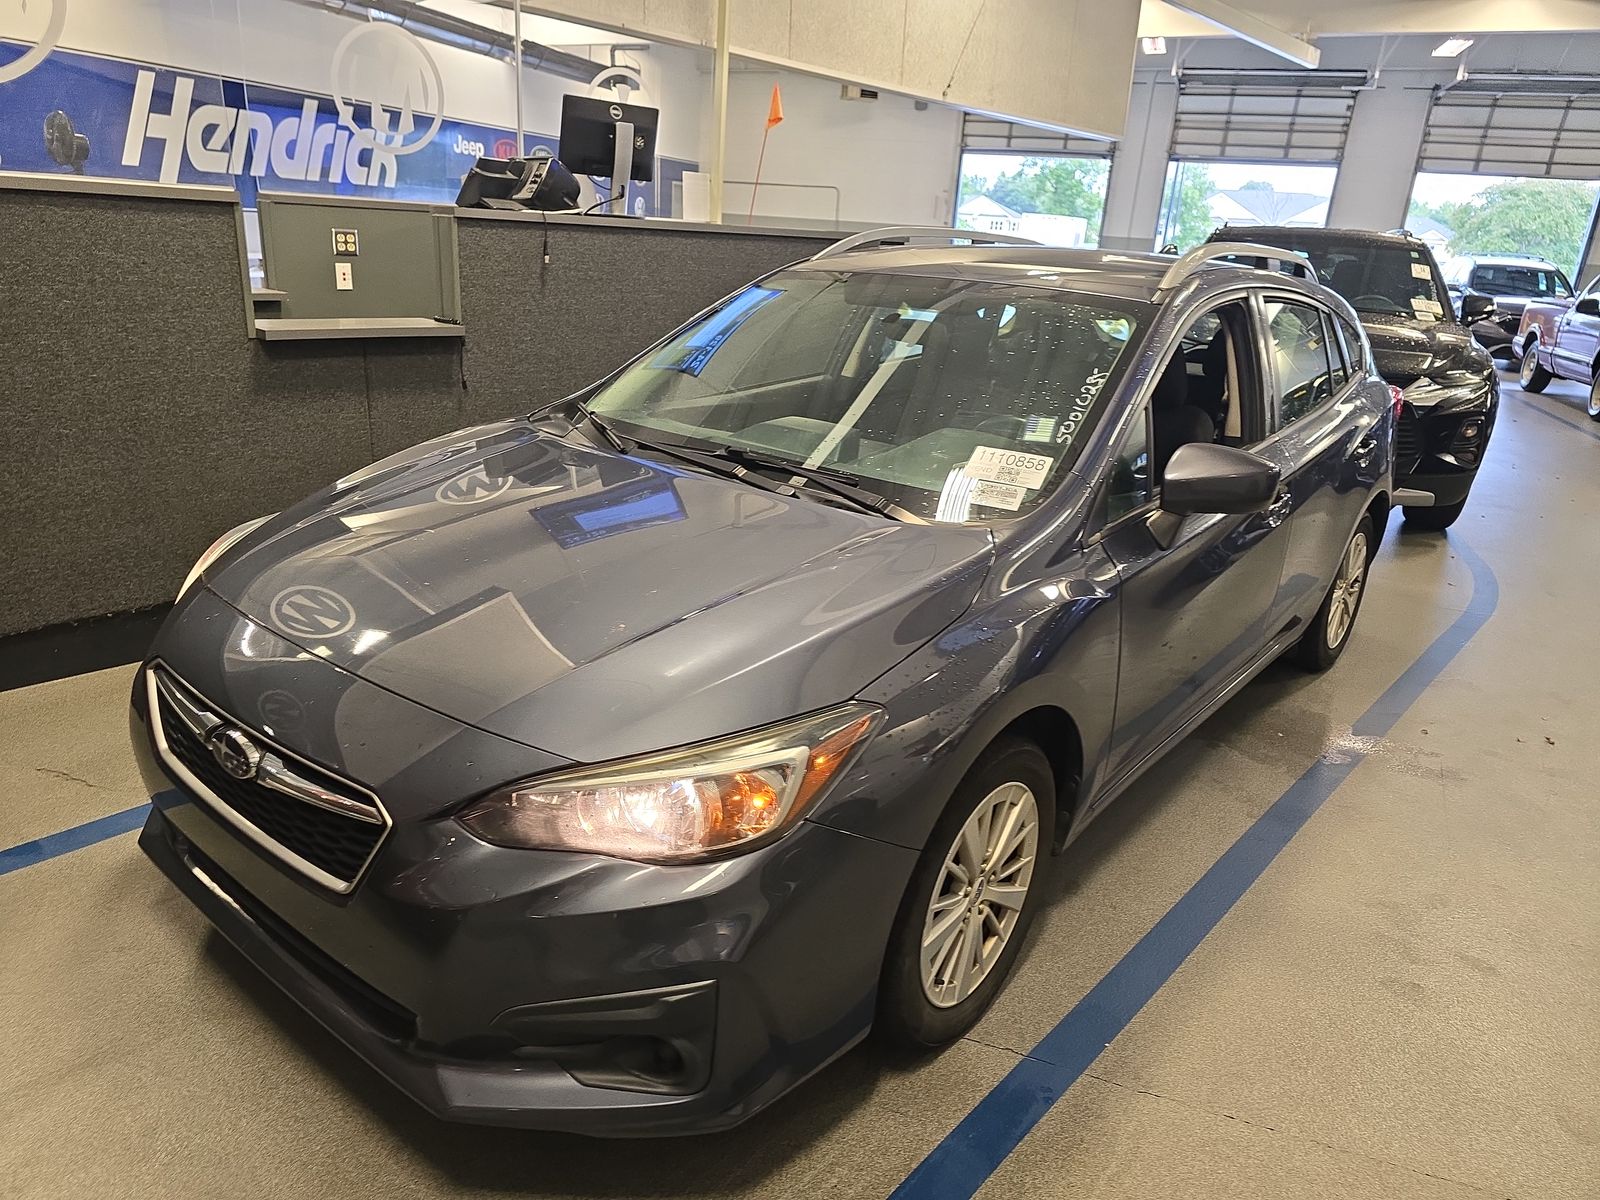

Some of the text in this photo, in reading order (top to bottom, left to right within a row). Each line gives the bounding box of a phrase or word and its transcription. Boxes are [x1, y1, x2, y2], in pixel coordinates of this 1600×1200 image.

[121, 69, 397, 188] Hendrick
[453, 134, 484, 159] Jeep
[979, 449, 1046, 471] 1110858
